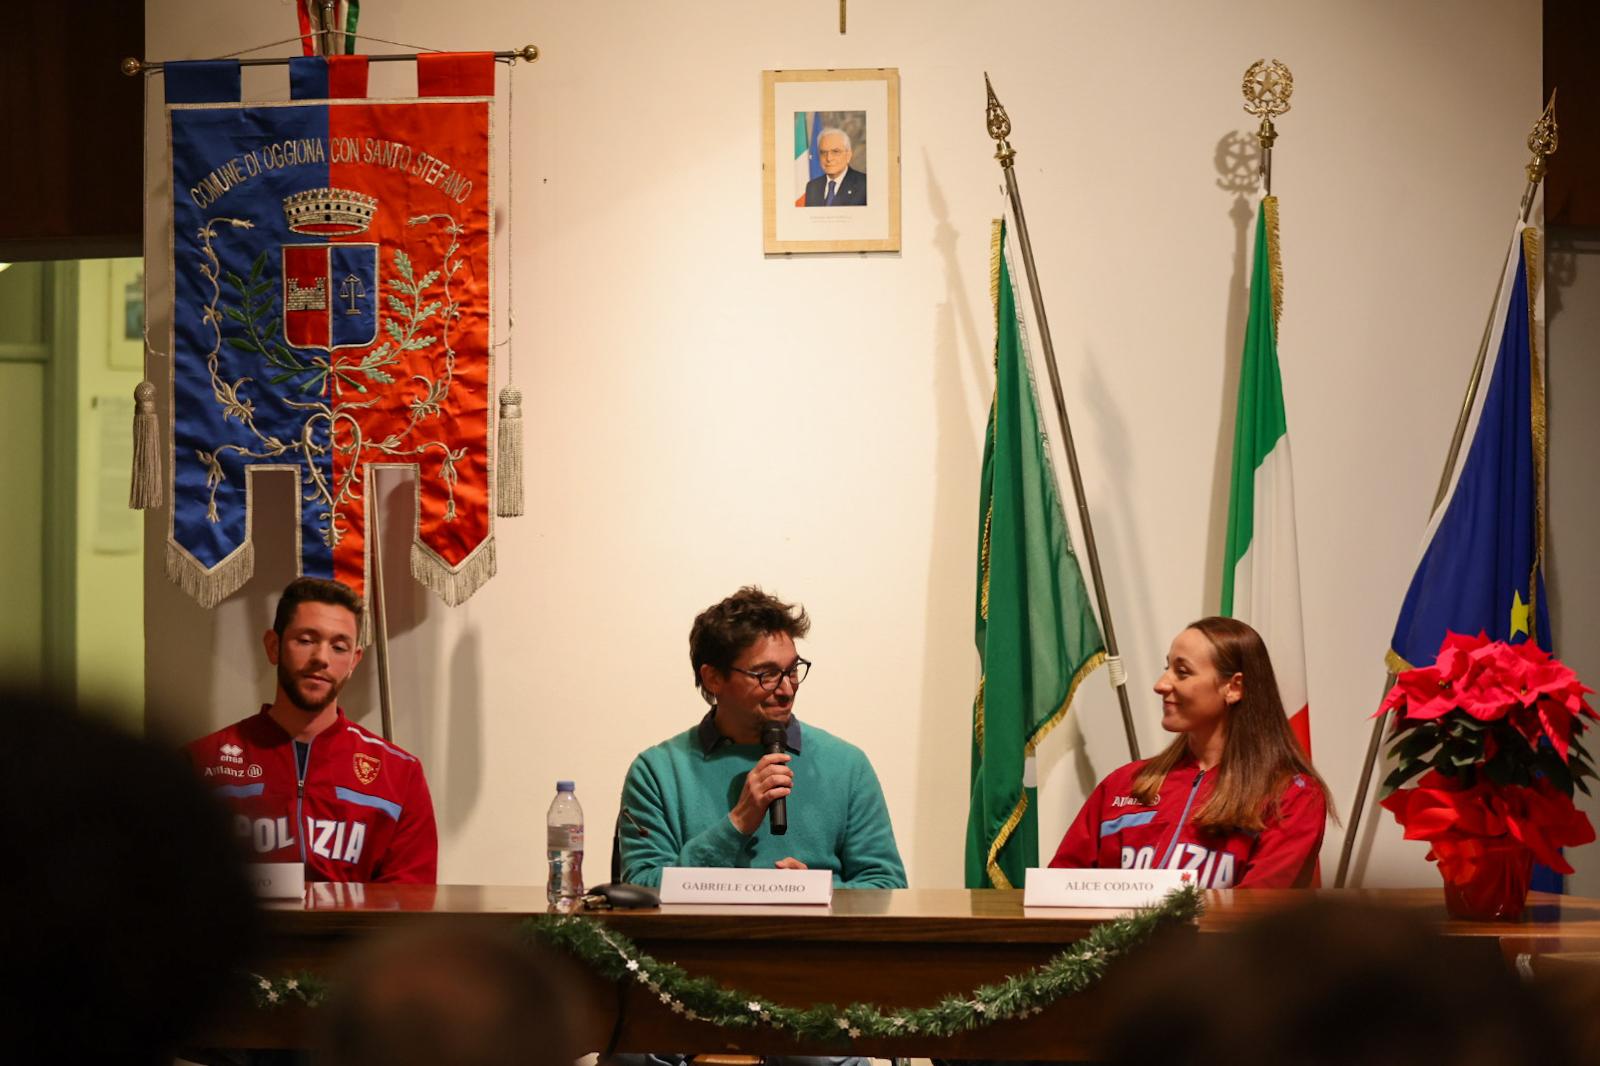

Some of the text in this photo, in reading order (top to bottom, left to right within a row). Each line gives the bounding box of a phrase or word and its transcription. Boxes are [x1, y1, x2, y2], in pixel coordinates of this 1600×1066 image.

[190, 136, 474, 210] COMUNE DI OGGIONA CON SANTO STEFANO
[204, 765, 246, 778] Allianz
[682, 881, 807, 894] GABRIELE COLOMBO
[1065, 880, 1155, 892] ALICE CODATO
